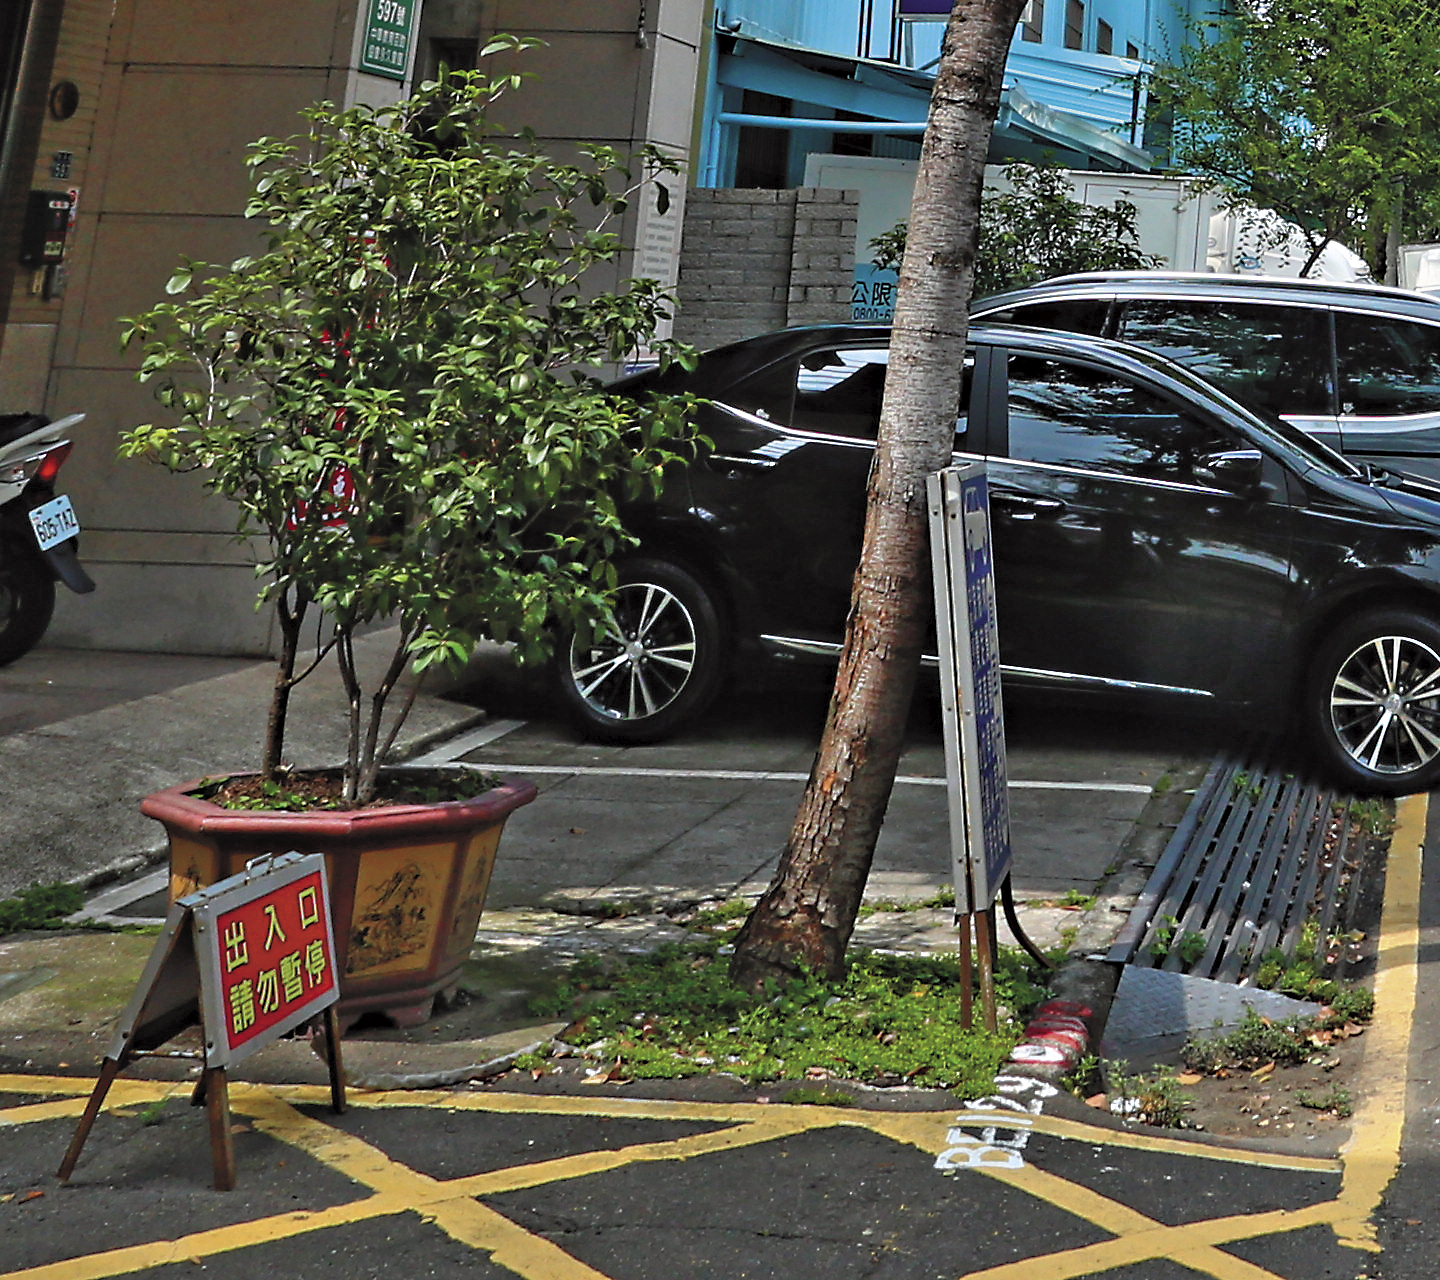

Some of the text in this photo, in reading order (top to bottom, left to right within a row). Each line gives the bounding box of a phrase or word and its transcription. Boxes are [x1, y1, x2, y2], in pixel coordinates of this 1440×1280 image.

[223, 886, 320, 973] 出入口
[229, 939, 327, 1034] 請勿暫停
